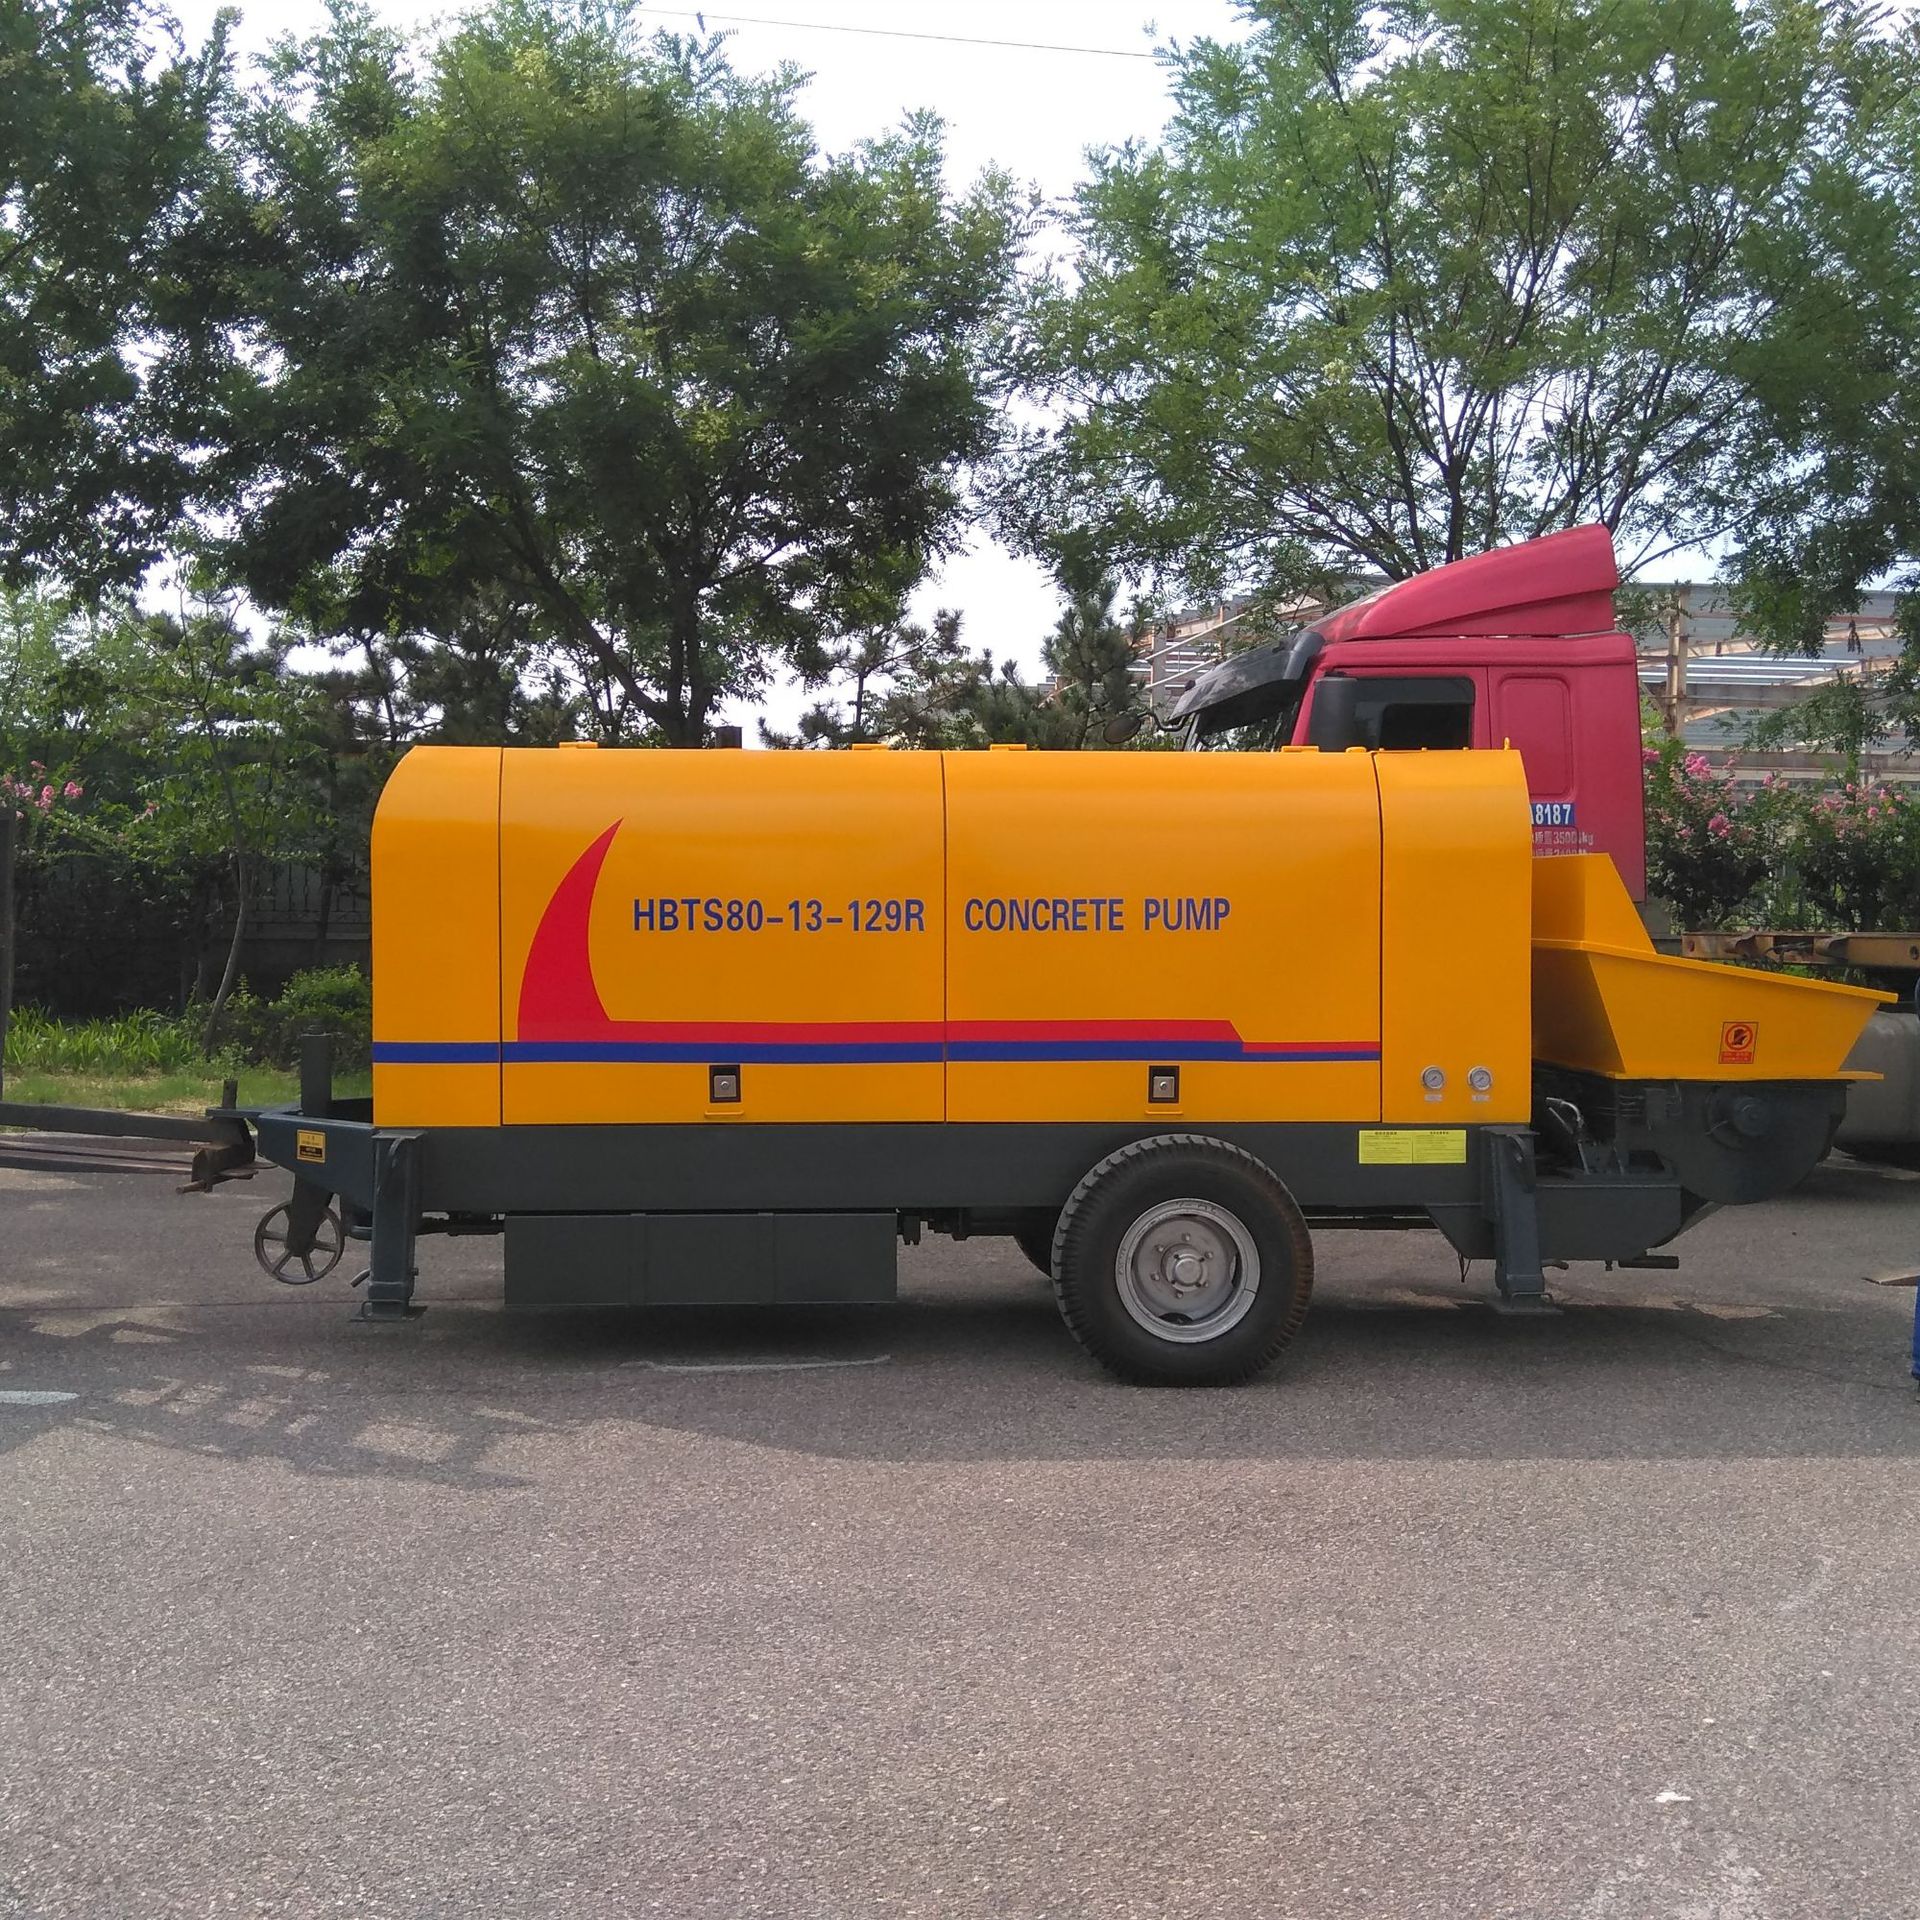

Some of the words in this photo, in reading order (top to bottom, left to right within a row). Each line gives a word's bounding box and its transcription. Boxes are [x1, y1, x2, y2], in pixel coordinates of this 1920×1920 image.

[633, 898, 926, 932] HBTS80-13-129R
[964, 898, 1124, 931] CONCRETE
[1144, 898, 1231, 931] PUMP
